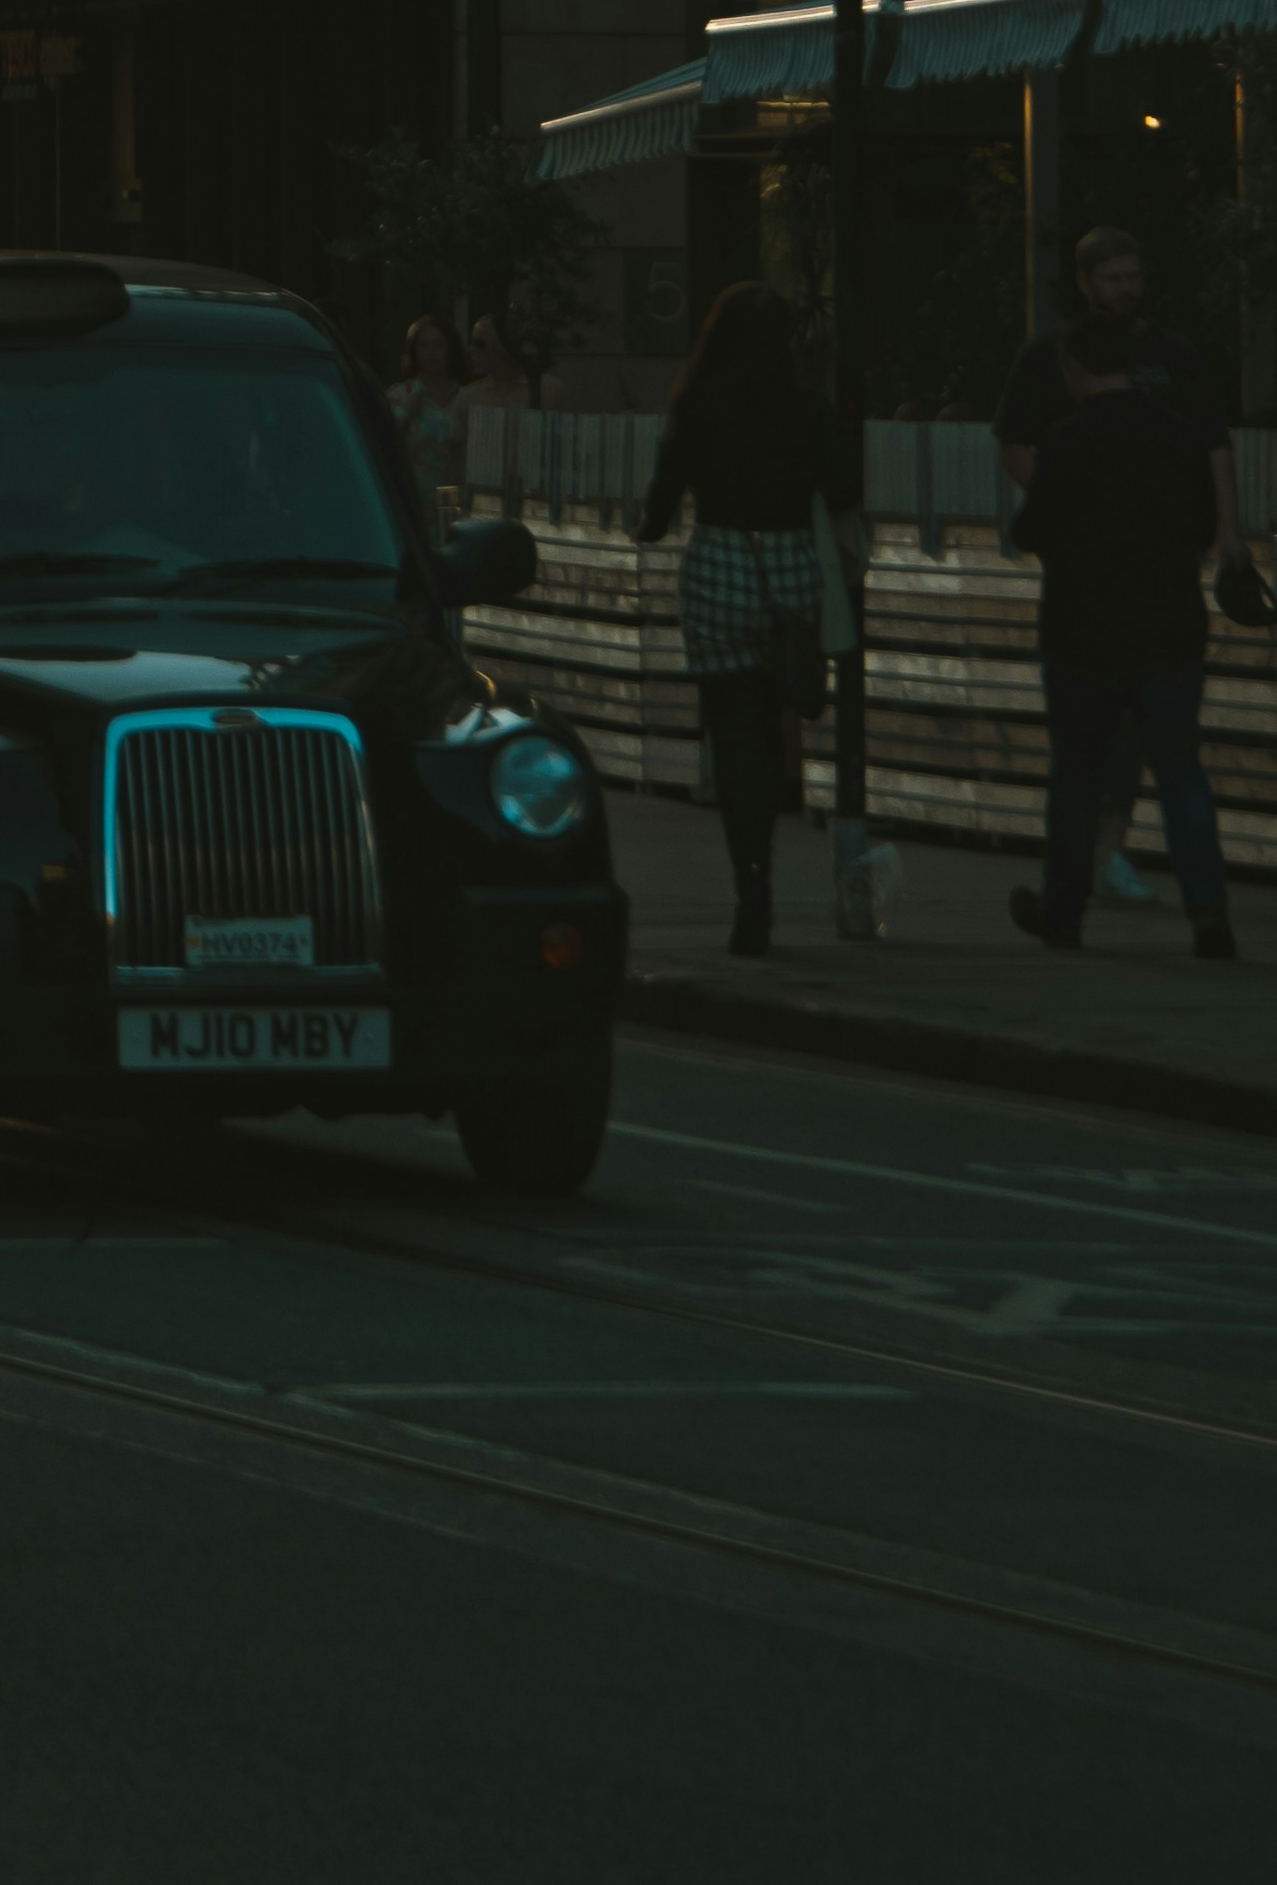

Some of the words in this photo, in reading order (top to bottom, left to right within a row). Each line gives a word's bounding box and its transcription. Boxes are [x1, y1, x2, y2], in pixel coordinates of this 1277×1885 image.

[647, 262, 686, 321] 5
[150, 1012, 256, 1057] MJ10
[271, 1012, 360, 1057] MBY
